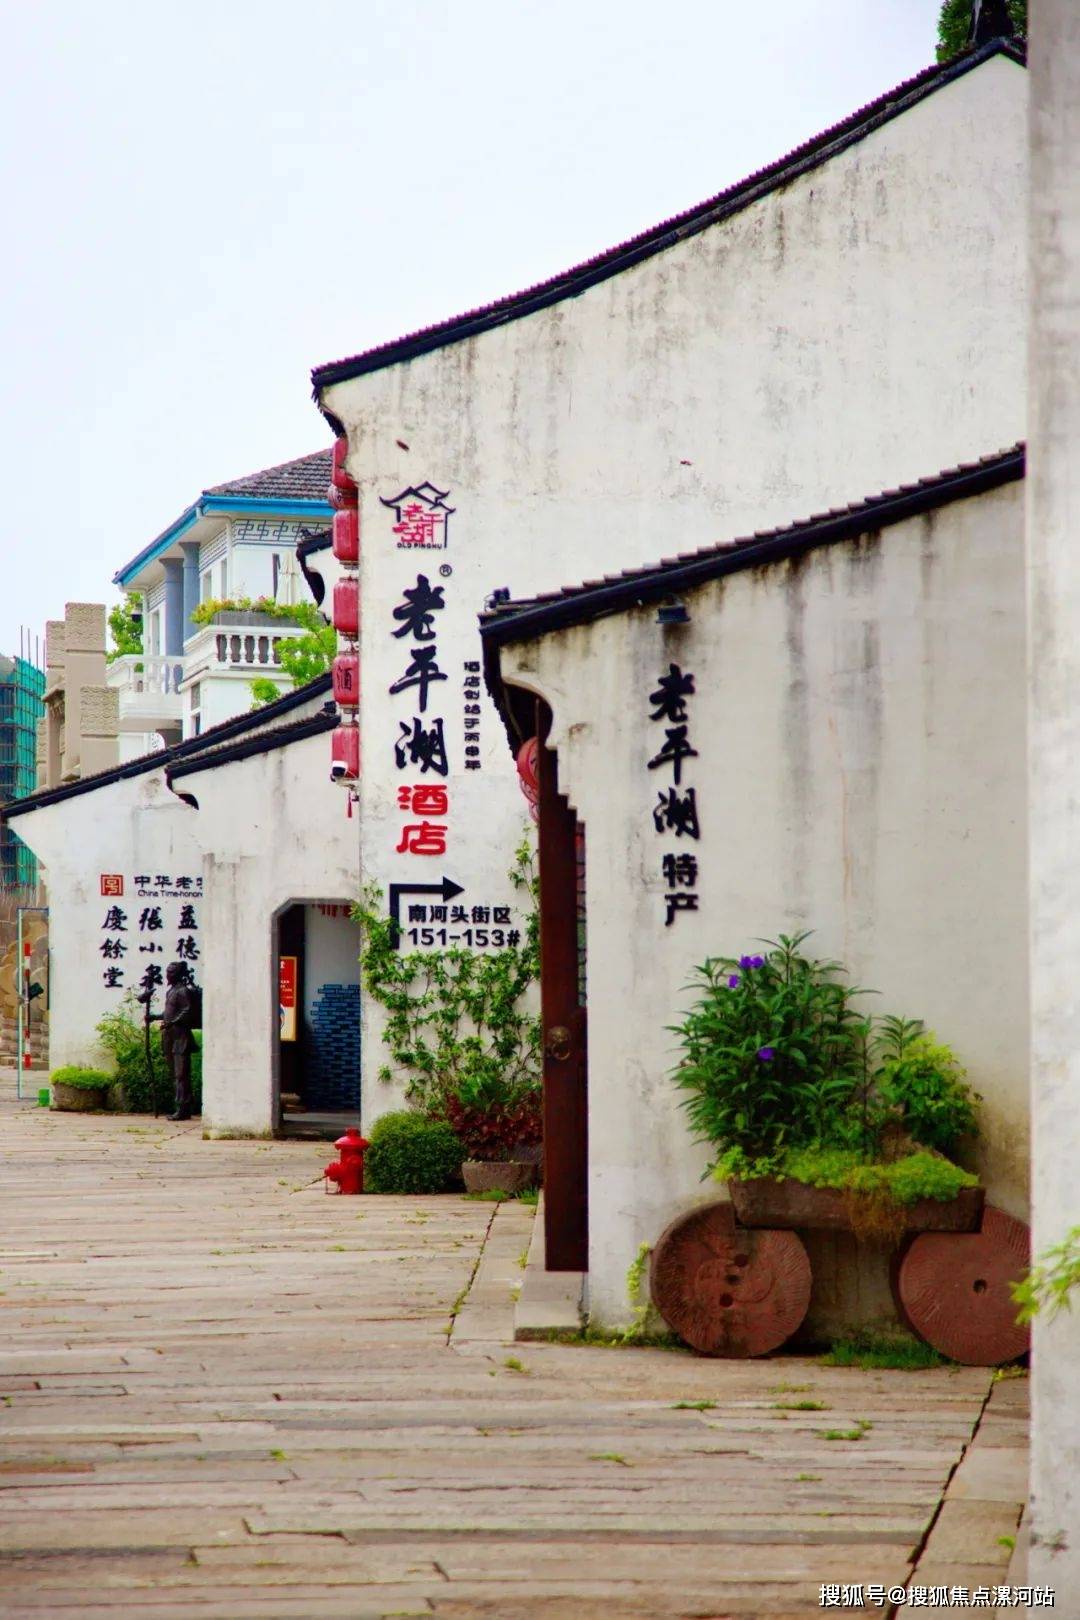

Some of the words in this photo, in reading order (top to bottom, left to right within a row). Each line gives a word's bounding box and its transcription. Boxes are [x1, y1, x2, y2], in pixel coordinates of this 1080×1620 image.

[138, 889, 159, 897] China
[408, 904, 512, 925] 南河头街区
[407, 927, 521, 947] 151-153#
